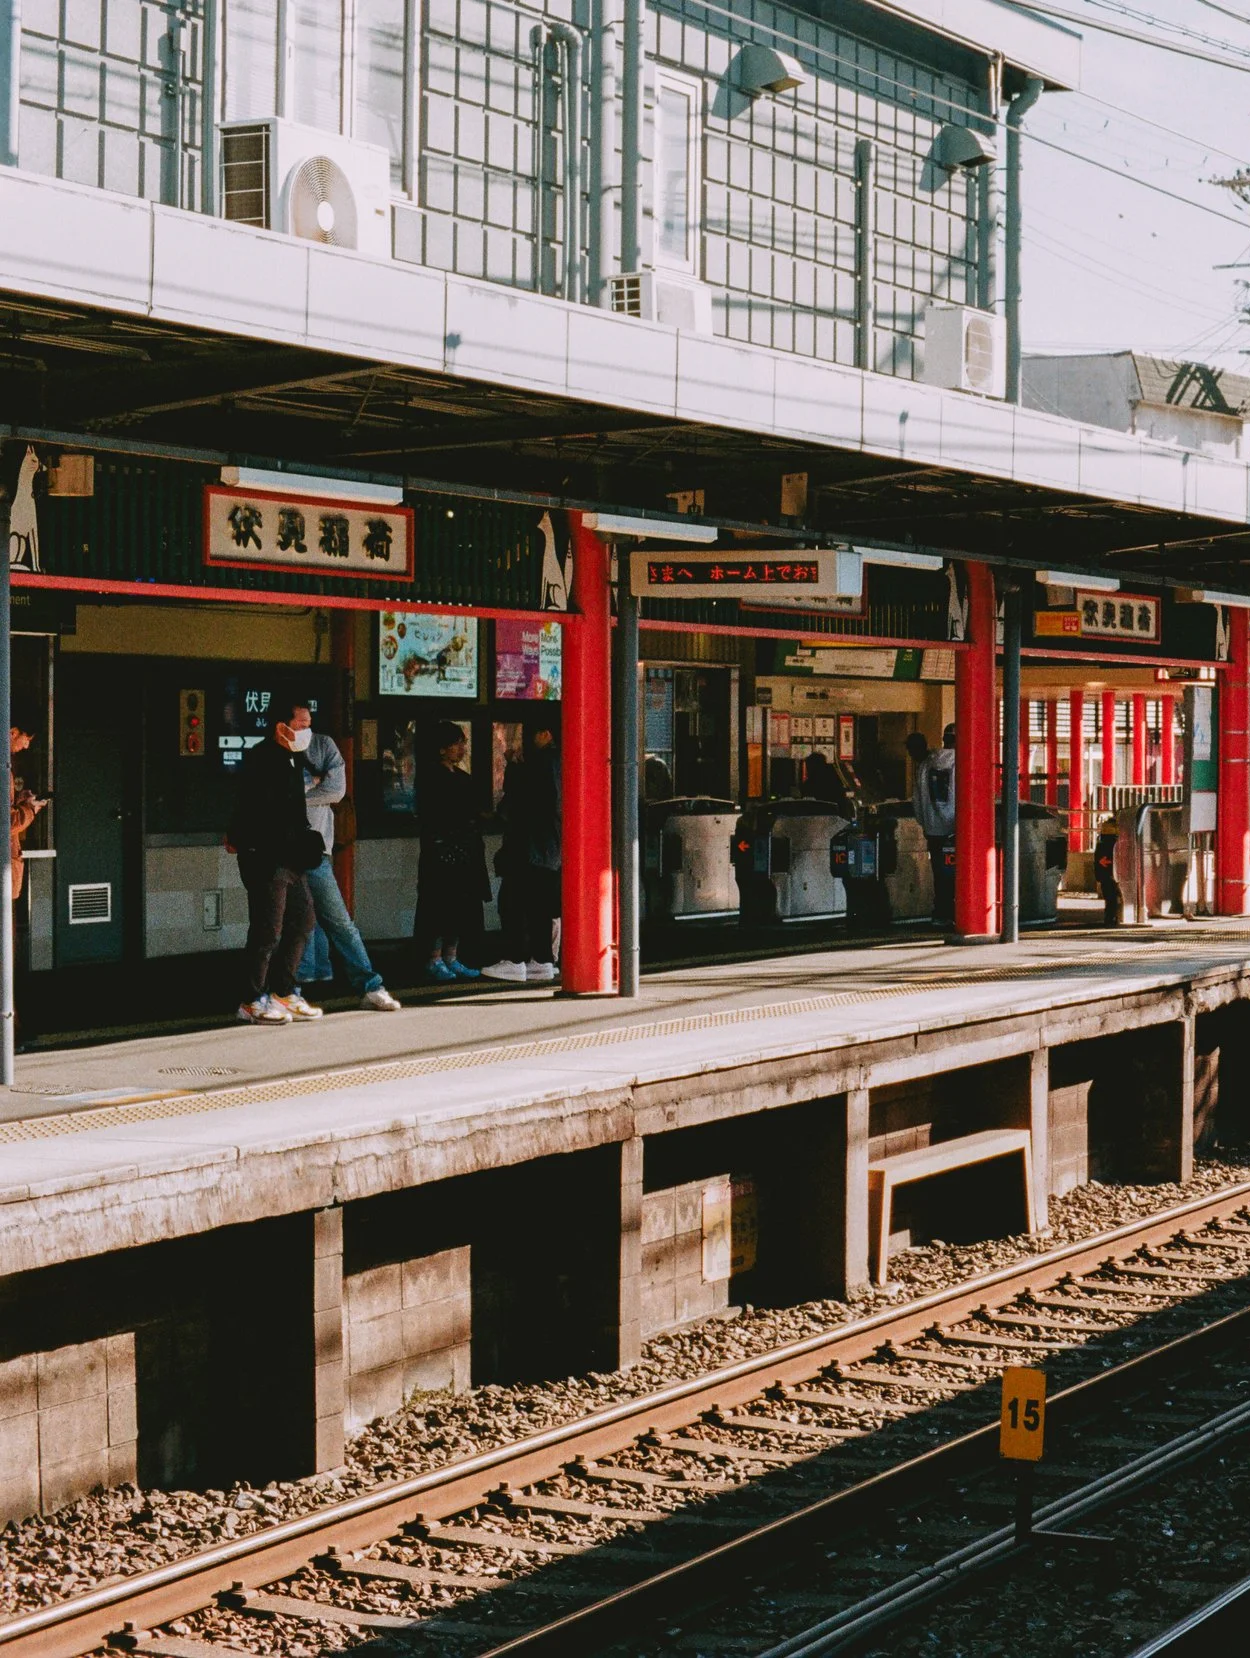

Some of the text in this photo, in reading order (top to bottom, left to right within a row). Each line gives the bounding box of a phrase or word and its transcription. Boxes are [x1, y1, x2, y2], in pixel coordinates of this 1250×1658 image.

[228, 503, 393, 562] 伏見稲荷
[1082, 599, 1153, 632] 伏見稲荷
[1008, 1397, 1040, 1432] 15
